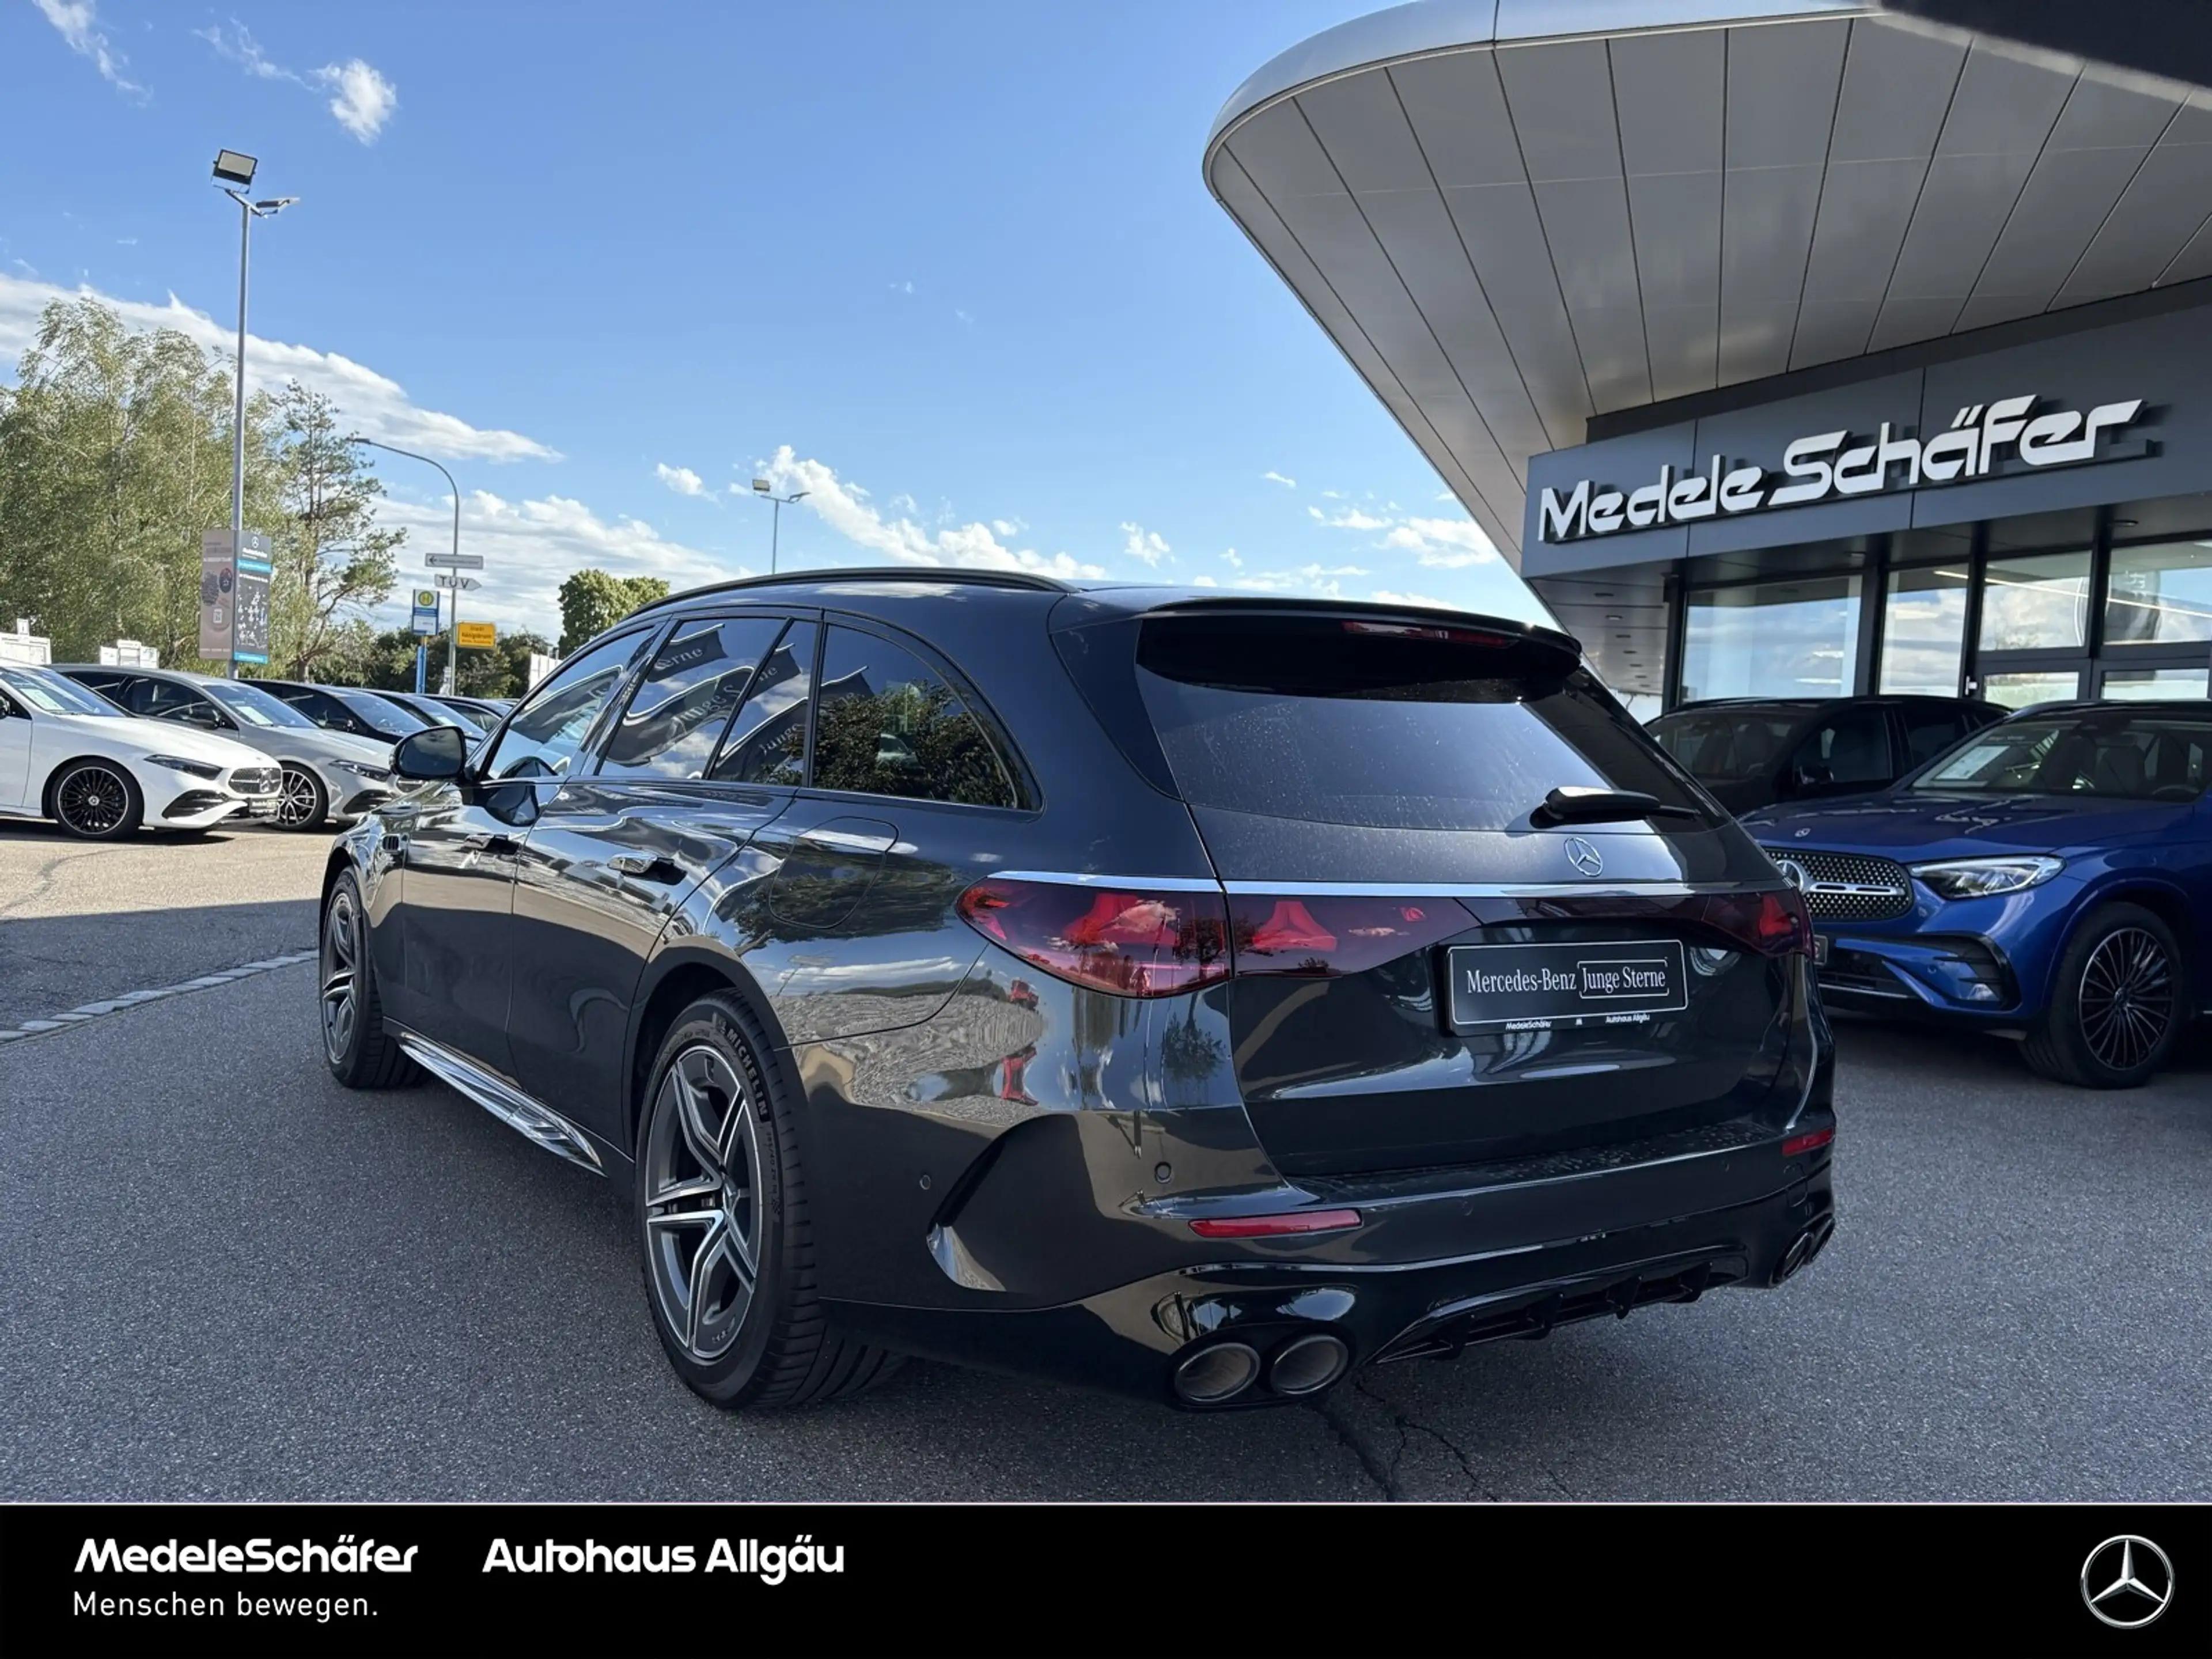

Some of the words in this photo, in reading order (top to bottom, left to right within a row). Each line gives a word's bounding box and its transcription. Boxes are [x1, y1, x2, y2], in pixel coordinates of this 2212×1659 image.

[1467, 967, 1577, 994] Mercedes-Benz
[1582, 967, 1620, 994] Junge
[1622, 965, 1666, 988] Sterne
[726, 1028, 768, 1116] MICHELIN
